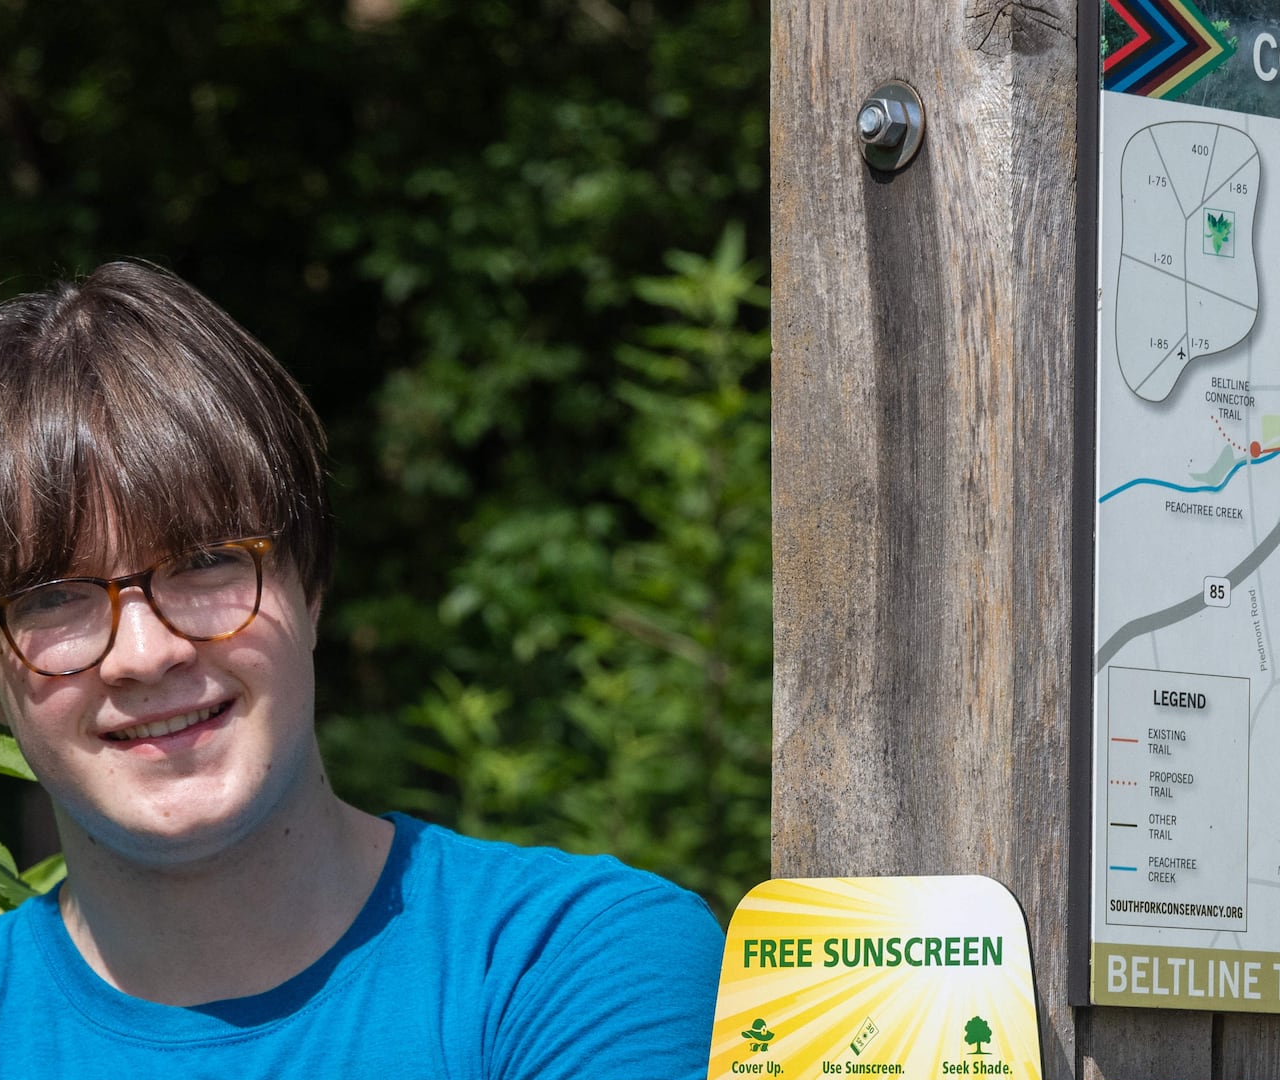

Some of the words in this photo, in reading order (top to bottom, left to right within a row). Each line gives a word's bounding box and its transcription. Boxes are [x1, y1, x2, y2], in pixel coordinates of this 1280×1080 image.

[1192, 145, 1208, 155] 400
[1148, 175, 1167, 187] I-75
[1230, 184, 1247, 194] I-85
[1154, 253, 1172, 265] I-20
[1150, 338, 1168, 349] I-85
[1192, 338, 1209, 349] I-75
[1212, 377, 1249, 390] BELTLINE
[1205, 391, 1254, 407] CONNECTOR
[1219, 408, 1241, 420] TRAIL
[1166, 501, 1213, 516] PEACHTREE
[1216, 507, 1242, 519] CREEK
[1210, 585, 1224, 599] 85
[1154, 690, 1206, 709] LEGEND
[1149, 729, 1185, 741] EXISTING
[1149, 744, 1171, 755] TRAIL
[1150, 771, 1193, 784] PROPOSED
[1150, 786, 1173, 798] TRAIL
[1149, 814, 1176, 825] OTHER
[1149, 828, 1172, 840] TRAIL
[1149, 857, 1196, 869] PEACHTREE
[1149, 872, 1176, 883] CREEK
[1110, 900, 1242, 918] SOUTHFORKCONSERVANCY.ORG
[744, 939, 812, 968] FREE
[824, 936, 1003, 967] SUNSCREEN
[1107, 955, 1261, 999] BELTLINE
[732, 1061, 763, 1074] Cover
[767, 1061, 784, 1075] Up.
[823, 1061, 842, 1074] Use
[845, 1061, 904, 1074] Sunscreen.
[942, 1061, 969, 1074] Seek
[972, 1061, 1012, 1074] Shade.
